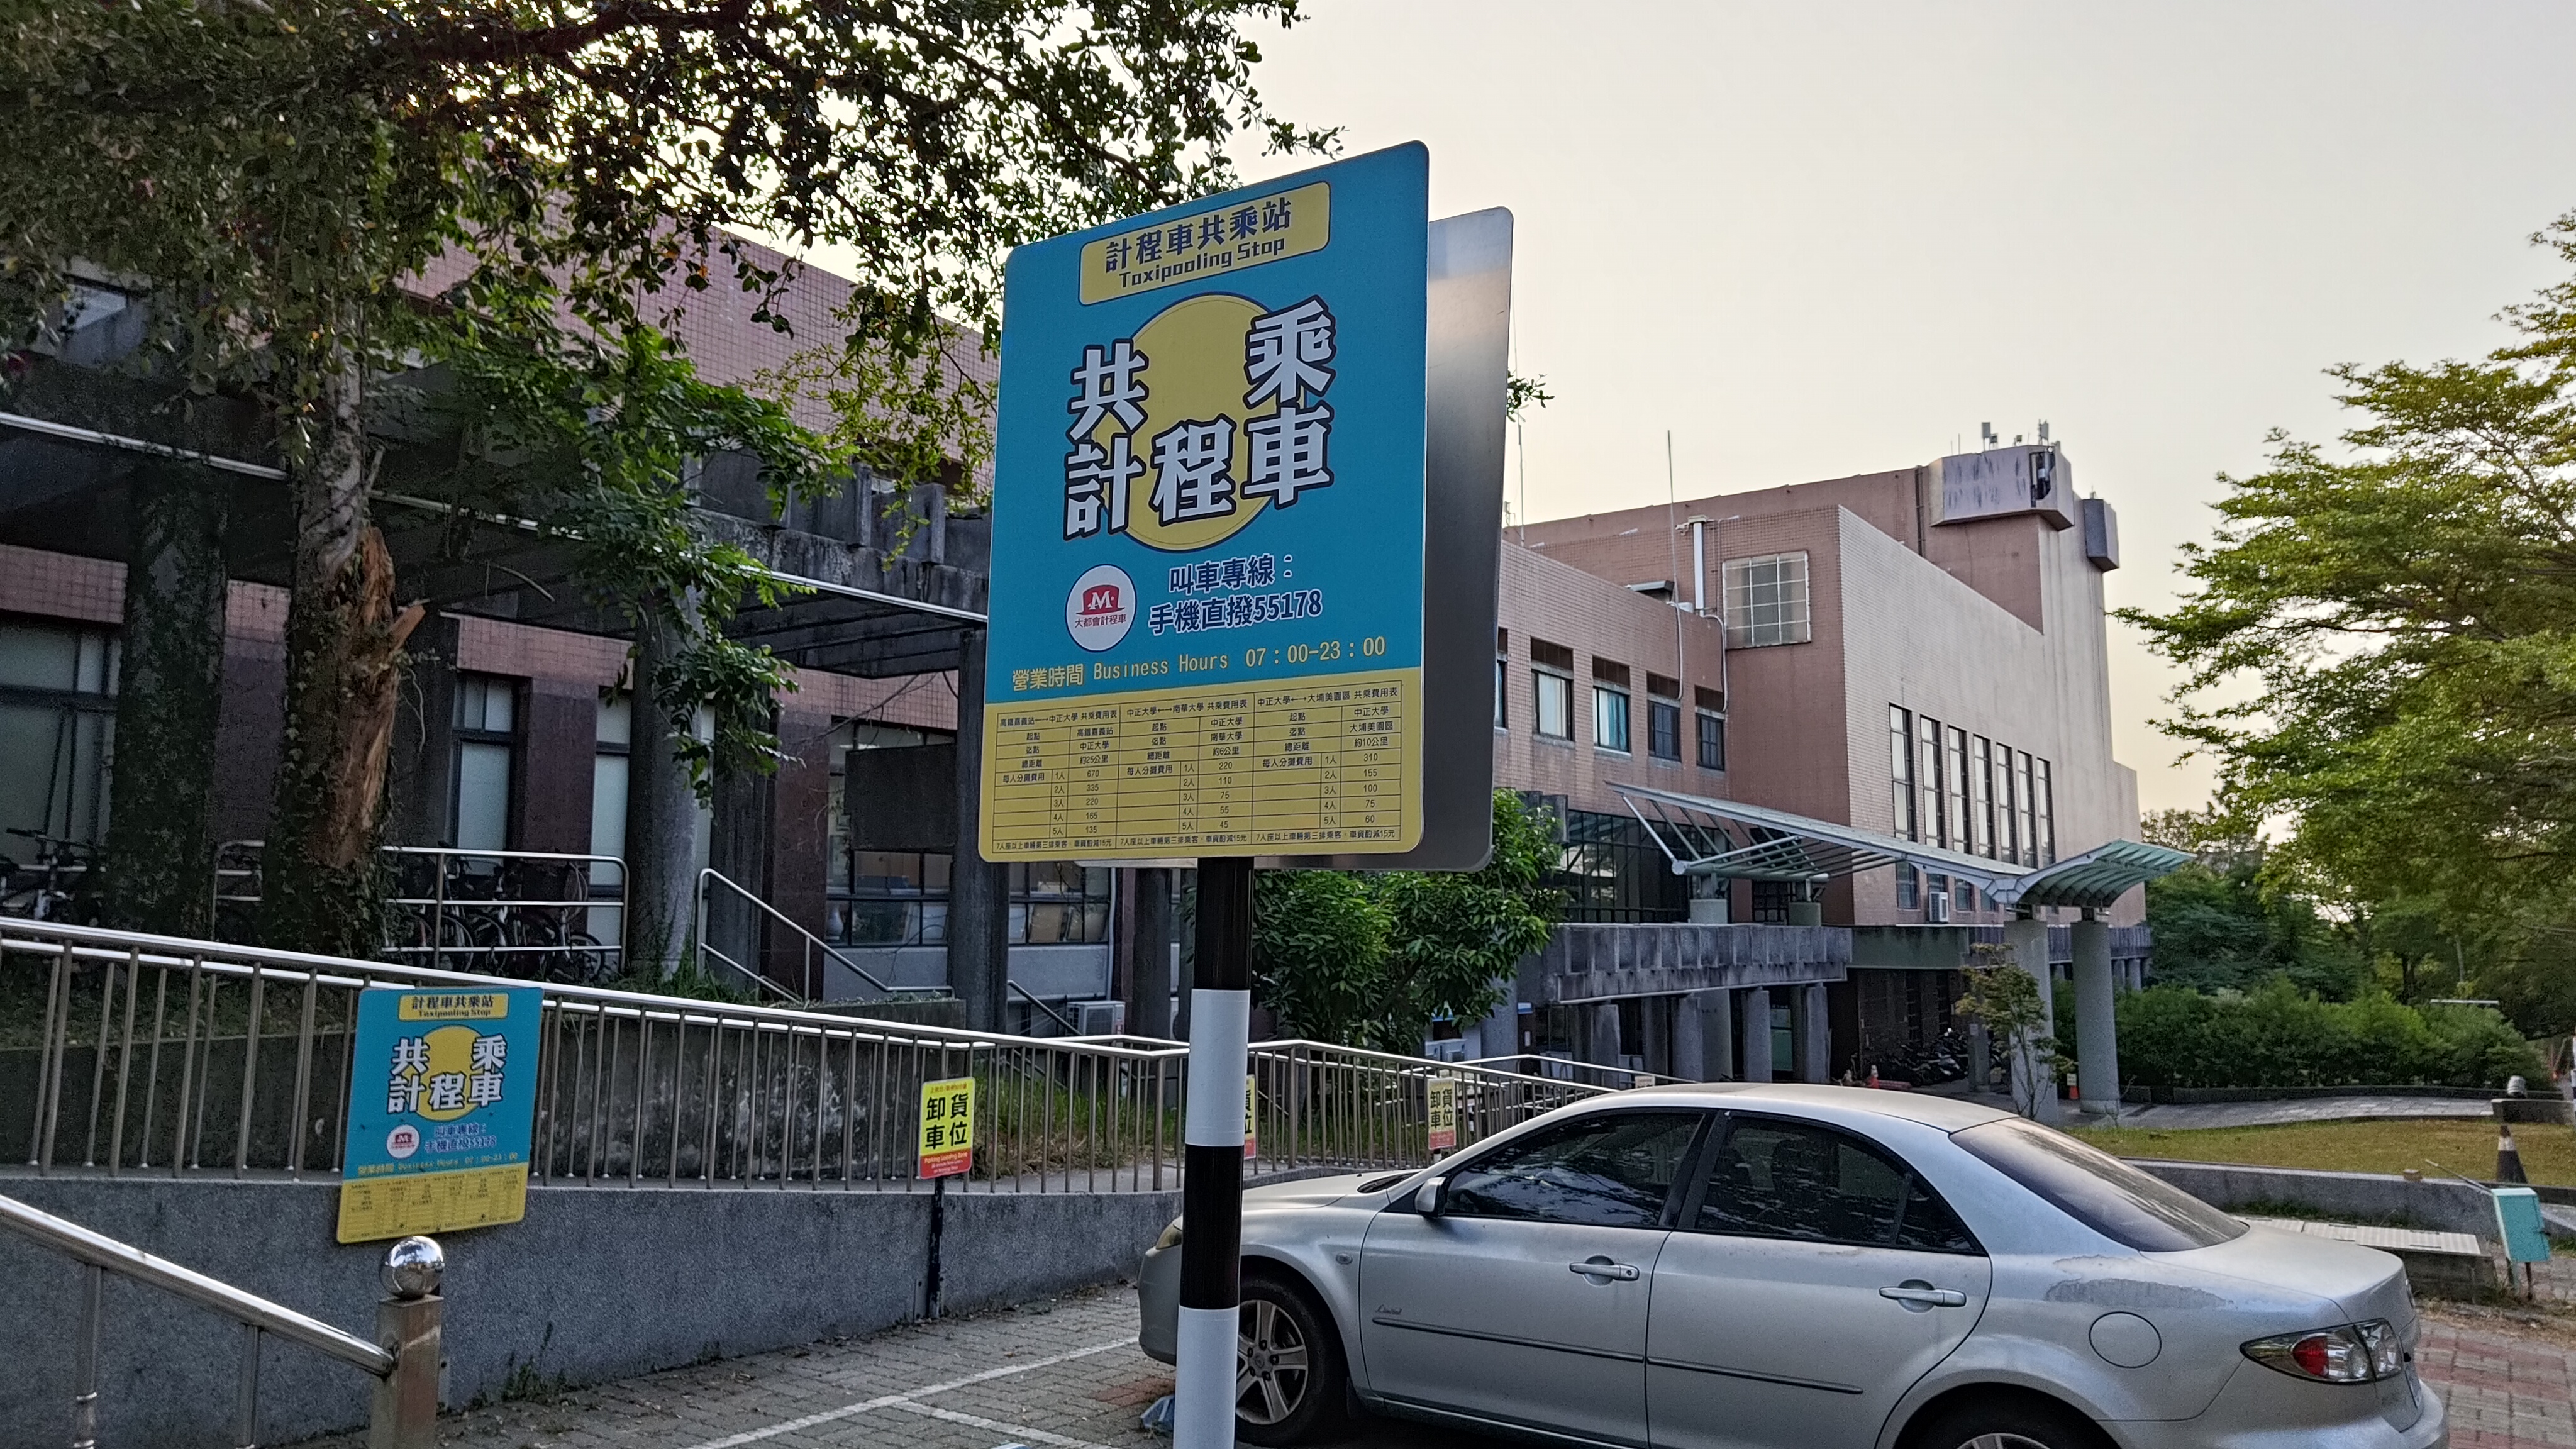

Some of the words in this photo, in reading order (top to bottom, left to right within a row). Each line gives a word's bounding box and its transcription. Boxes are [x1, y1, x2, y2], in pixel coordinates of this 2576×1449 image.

[1106, 197, 1292, 274] 計程車共乘站
[1119, 250, 1232, 288] Taxipooling
[1237, 238, 1285, 260] Stop
[1063, 401, 1335, 541] 計程車
[1148, 589, 1323, 636] 手機直撥55178
[1075, 614, 1126, 628] 大都會計程車
[1012, 664, 1084, 692] 營業時間
[1094, 659, 1169, 680] Business
[1179, 652, 1228, 673] Hours
[1258, 696, 1291, 706] 中正大學
[1307, 691, 1350, 702] 大埔美園區
[1354, 687, 1397, 699] 共乘費用表
[1127, 706, 1157, 716] 中正大學
[1173, 703, 1204, 713] 南華大學
[1207, 699, 1247, 710] 共乘費用表
[1290, 713, 1306, 722] 起點
[1354, 707, 1389, 717] 中正大學
[1049, 713, 1078, 723] 中正大學
[1081, 710, 1117, 720] 共乘費用表
[1152, 723, 1167, 731] 起點
[1211, 717, 1243, 727] 中正大學
[1350, 721, 1393, 733] 大埔美園區
[1211, 731, 1243, 742] 南華大學
[1080, 741, 1109, 750] 中正大學
[1285, 742, 1309, 752] 總距離
[1355, 737, 1388, 747] 約10公里
[1147, 751, 1170, 760] 總距離
[1213, 747, 1240, 756] 約6公里
[1263, 757, 1313, 768] 每人分攤費用
[1325, 755, 1336, 764] 1人
[1363, 753, 1377, 762] 310
[1022, 759, 1042, 769] 總距離
[1080, 755, 1108, 764] 約25公里
[1127, 765, 1172, 775] 每人分攤費用
[1184, 764, 1194, 772] 1人
[1219, 762, 1232, 770] 220
[1055, 772, 1065, 780] 1人
[1324, 770, 1336, 780] 2人
[1363, 769, 1377, 777] 155
[1184, 778, 1194, 787] 2人
[1219, 777, 1231, 785] 110
[1183, 792, 1194, 801] 3人
[1324, 786, 1336, 795] 3人
[1363, 784, 1377, 792] 100
[1183, 807, 1194, 816] 4人
[1324, 801, 1336, 810] 4人
[1053, 813, 1063, 821] 4人
[1324, 816, 1336, 825] 5人
[1365, 815, 1375, 823] 60
[1053, 827, 1063, 835] 5人
[1182, 821, 1194, 830] 5人
[387, 1070, 503, 1115] 計程車
[1430, 1089, 1453, 1108] 卸貨
[926, 1092, 968, 1121] 卸貨
[1431, 1109, 1453, 1129] 車位
[925, 1121, 967, 1150] 車位
